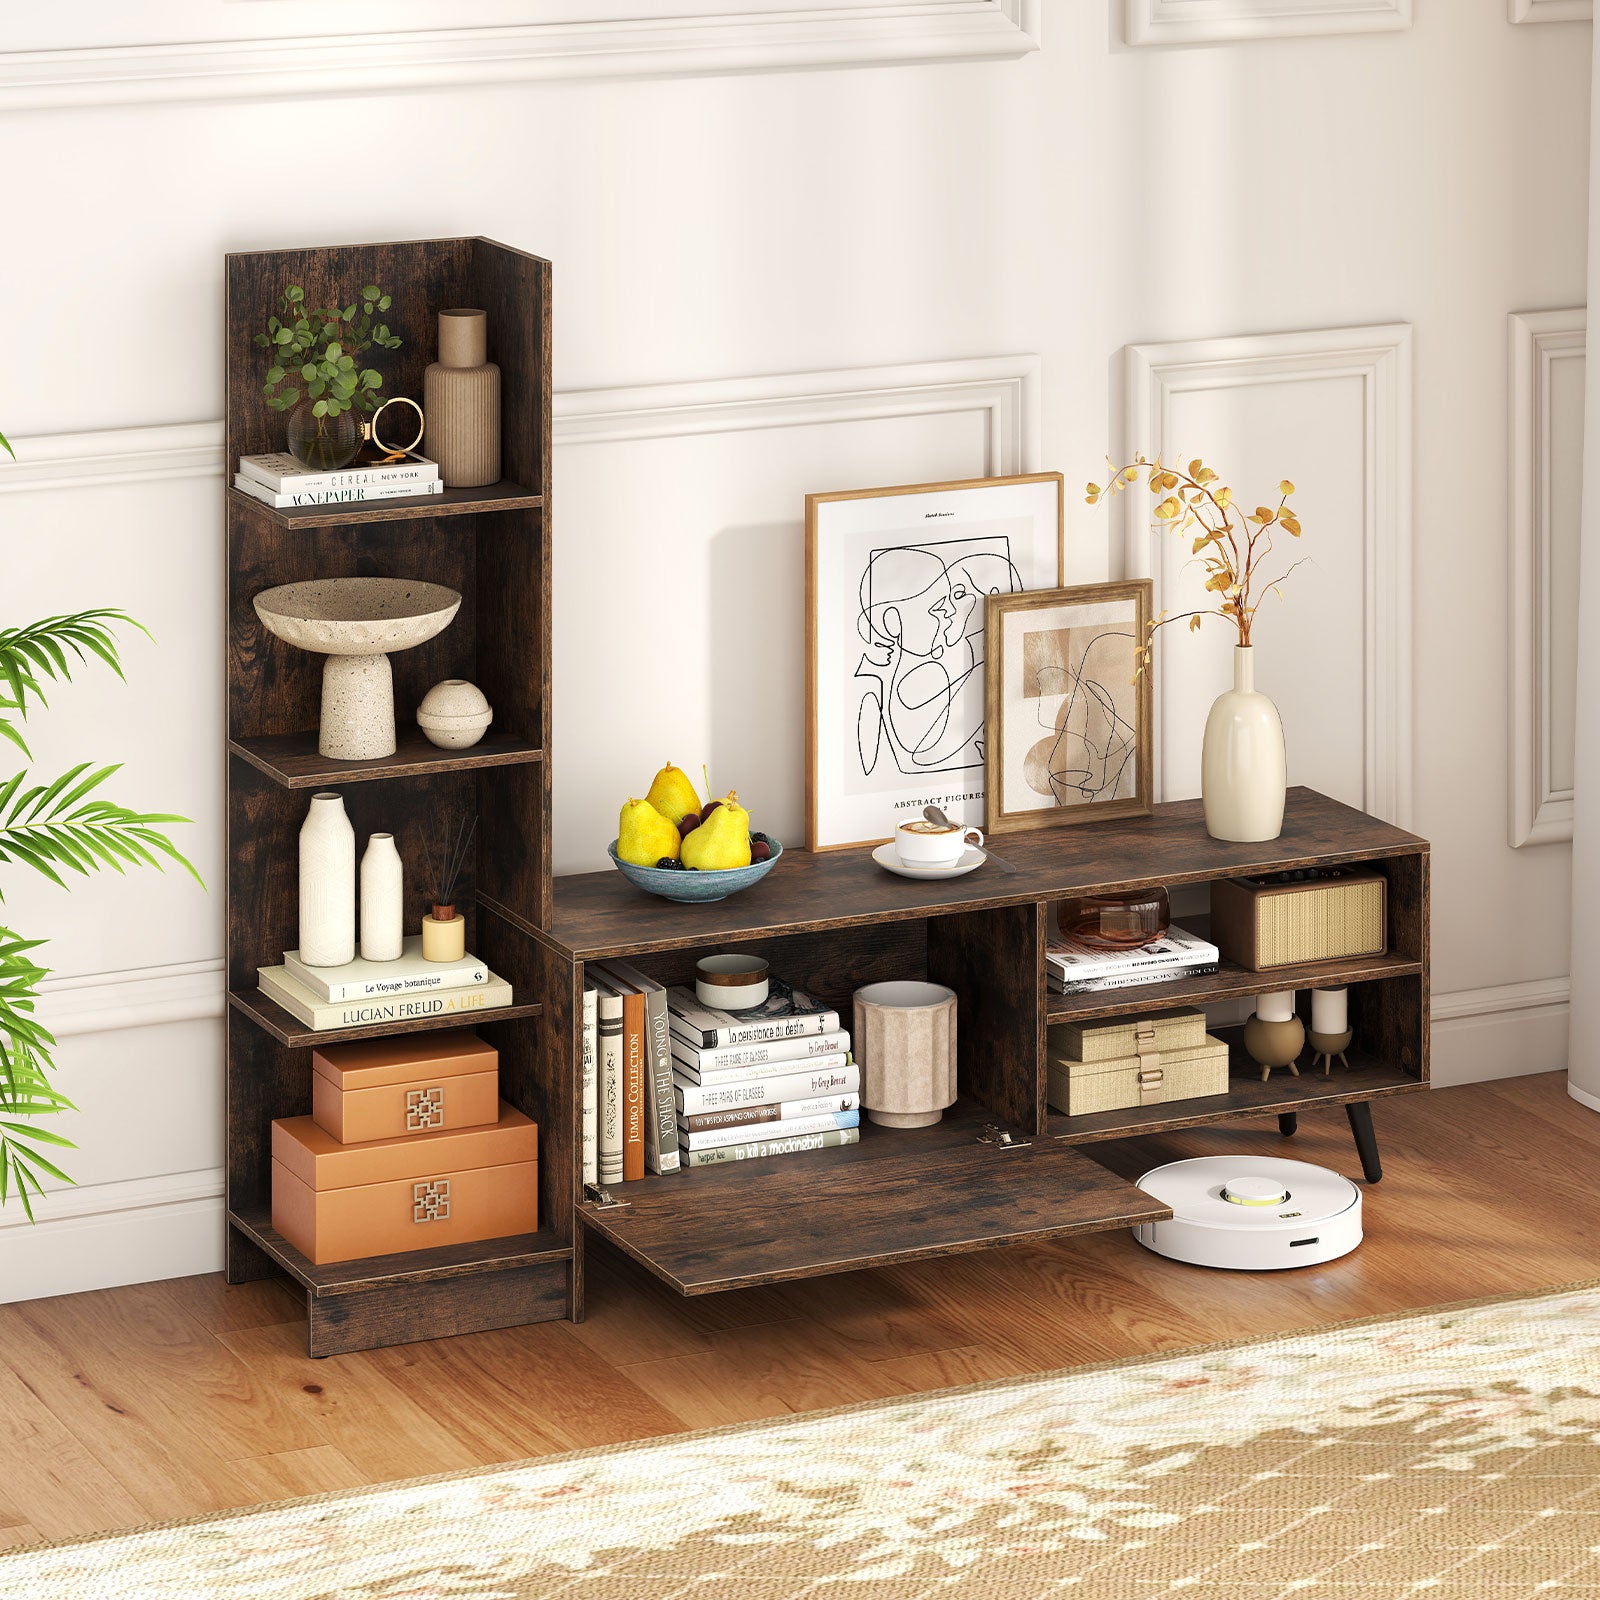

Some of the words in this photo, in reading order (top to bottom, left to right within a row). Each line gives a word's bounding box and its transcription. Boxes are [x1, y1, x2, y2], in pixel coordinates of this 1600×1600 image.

[331, 474, 376, 487] CEREAL
[400, 471, 419, 479] YORK
[894, 797, 942, 809] ABSTRACT
[945, 792, 985, 803] FIGURES
[365, 984, 375, 993] Le
[376, 981, 403, 992] Voyage
[404, 977, 441, 988] botanique
[343, 1005, 394, 1024] LUCIAN
[399, 999, 443, 1017] FREUD
[446, 999, 455, 1010] A
[460, 993, 485, 1009] LIFE
[653, 1011, 667, 1057] YOUNG
[775, 1023, 784, 1037] du
[628, 1033, 639, 1102] COLLECTION
[656, 1067, 671, 1095] THE
[702, 1092, 718, 1106] THREE
[734, 1089, 742, 1101] OF
[811, 1077, 818, 1093] by
[628, 1106, 641, 1143] JUMBO
[658, 1096, 675, 1140] SHACK
[734, 1147, 744, 1161] to
[746, 1143, 759, 1159] kill
[760, 1145, 767, 1156] a
[768, 1132, 824, 1155] mockingbird
